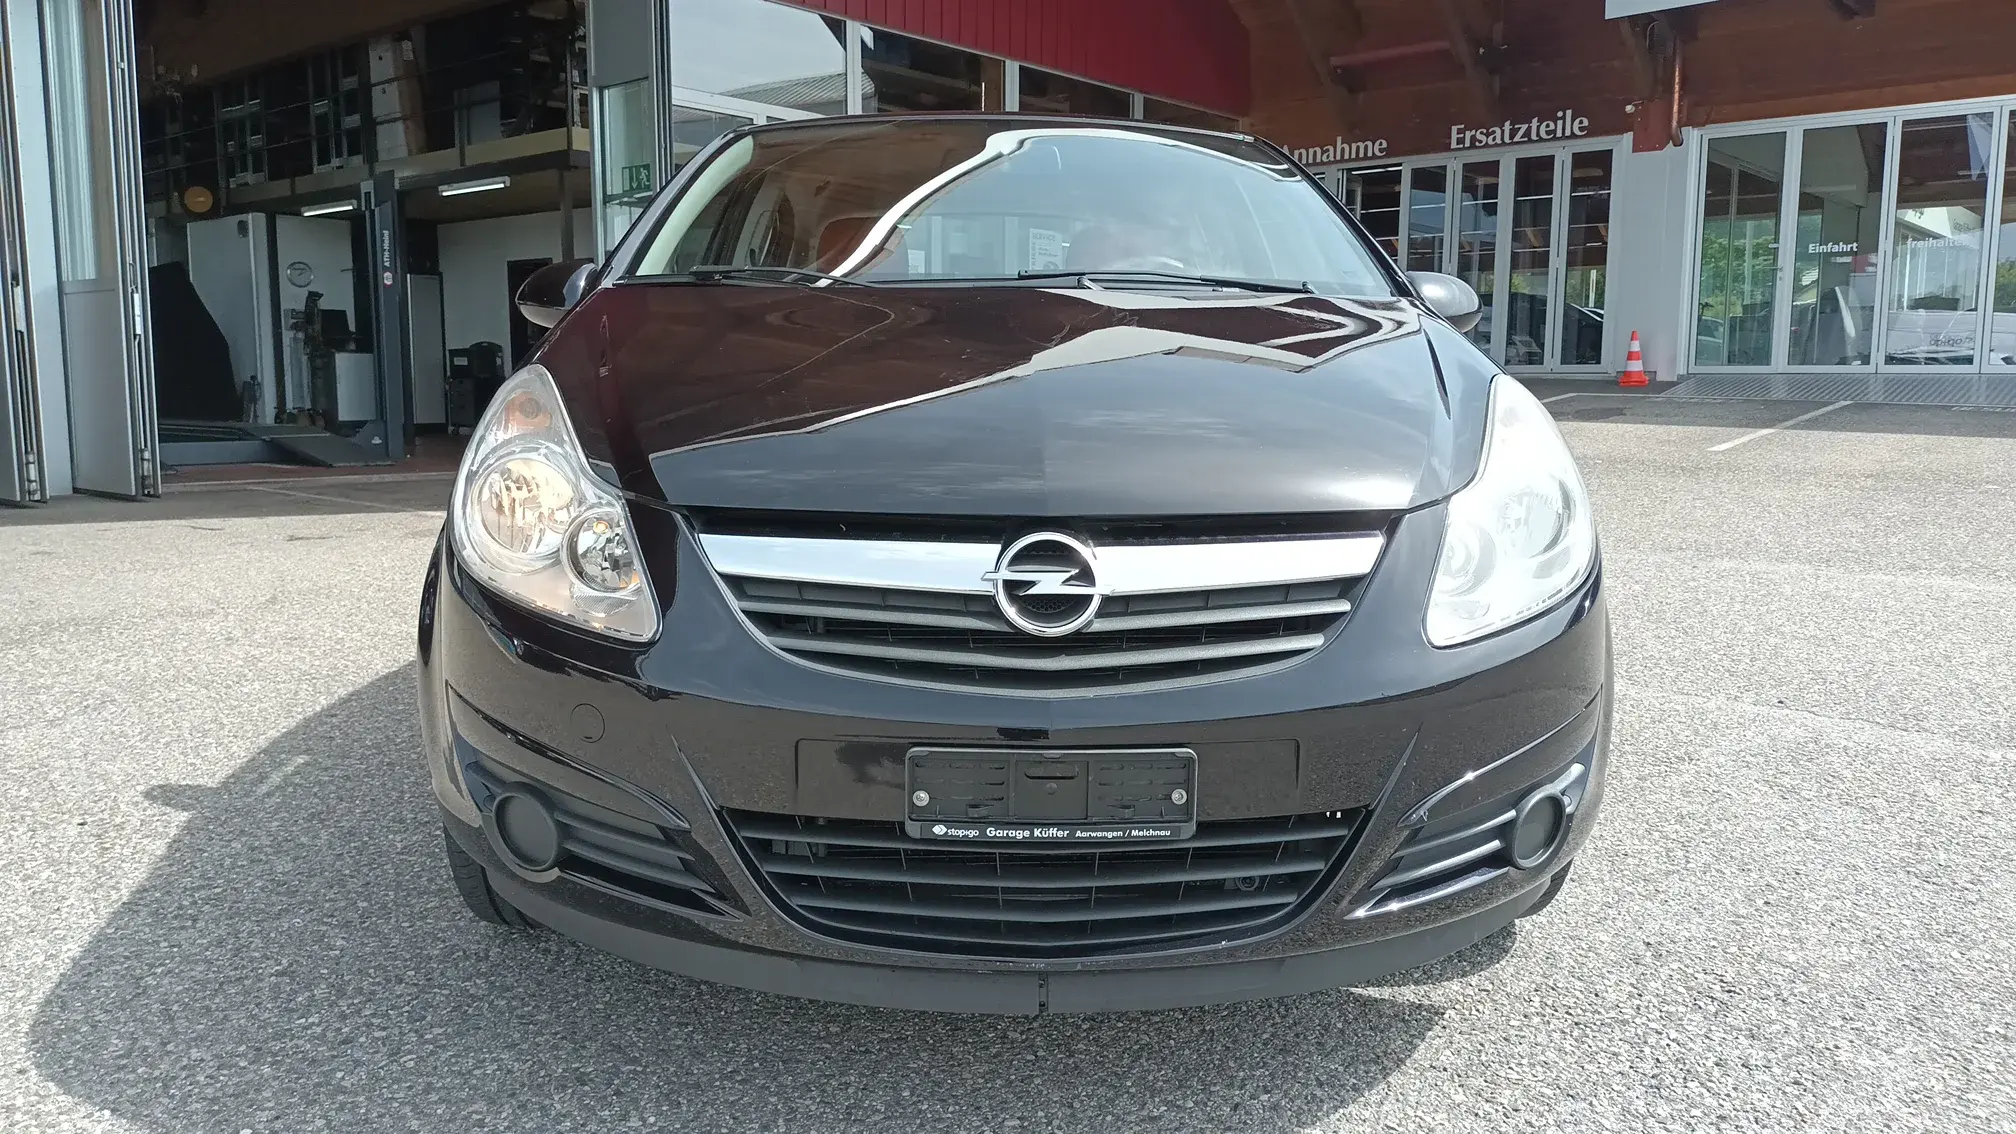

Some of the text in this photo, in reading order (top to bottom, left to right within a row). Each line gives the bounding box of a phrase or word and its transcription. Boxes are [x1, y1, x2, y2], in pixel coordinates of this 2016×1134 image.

[1450, 109, 1589, 149] Ersatzteile
[1808, 237, 1970, 254] Einfahrt freihalte
[986, 827, 1031, 839] Garage
[1033, 828, 1070, 838] Küffer
[1075, 830, 1123, 838] Aarwangen
[1131, 829, 1171, 837] Melchnau
